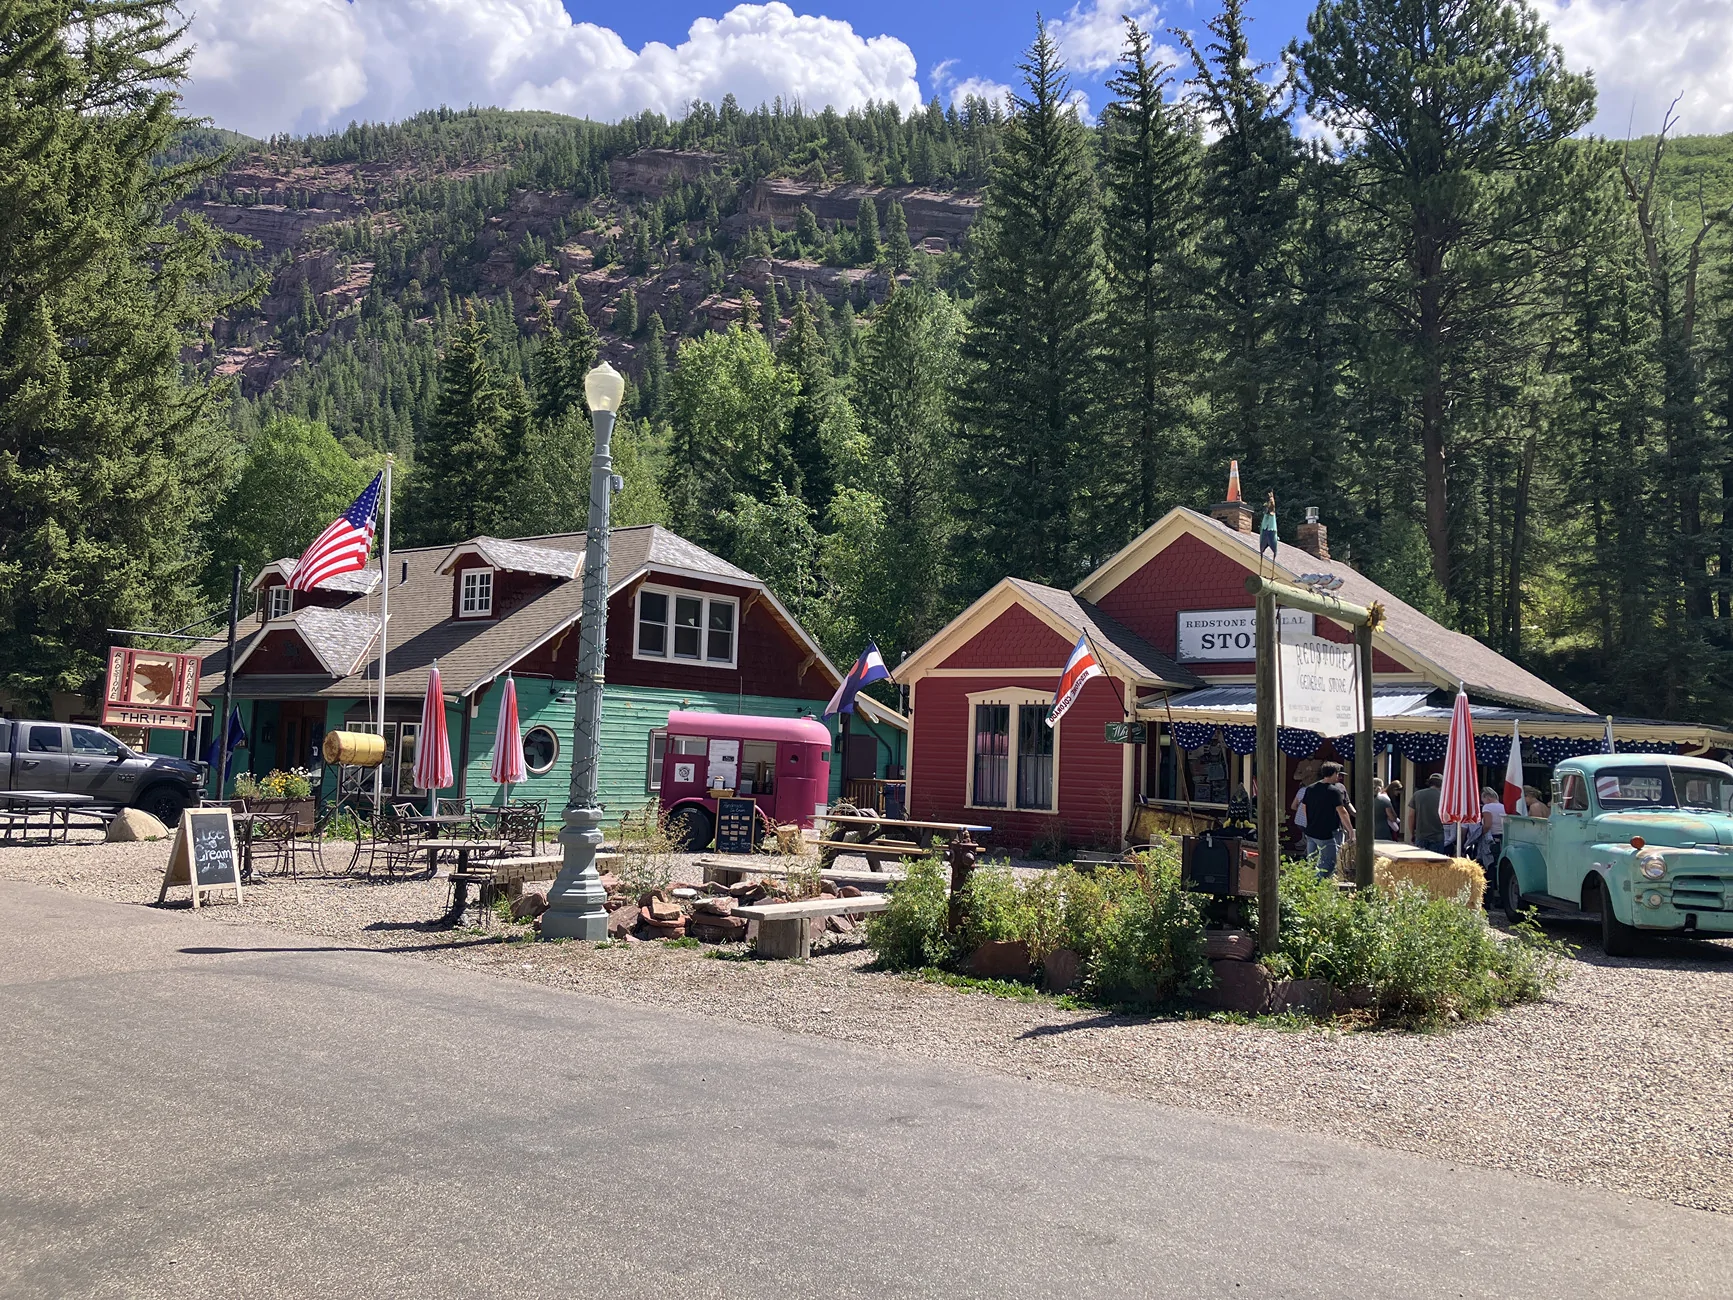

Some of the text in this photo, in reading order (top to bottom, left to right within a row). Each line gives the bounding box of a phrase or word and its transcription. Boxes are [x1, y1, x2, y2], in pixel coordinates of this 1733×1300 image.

[1186, 619, 1247, 628] REDSTONE
[1201, 632, 1256, 650] STO
[1295, 642, 1348, 671] REDSTONE
[110, 652, 122, 700] REDSTONE
[184, 659, 196, 704] GENERAL
[1300, 674, 1347, 693] GENERAL STORE
[120, 712, 179, 725] THRIFT
[194, 844, 232, 861] Cream
